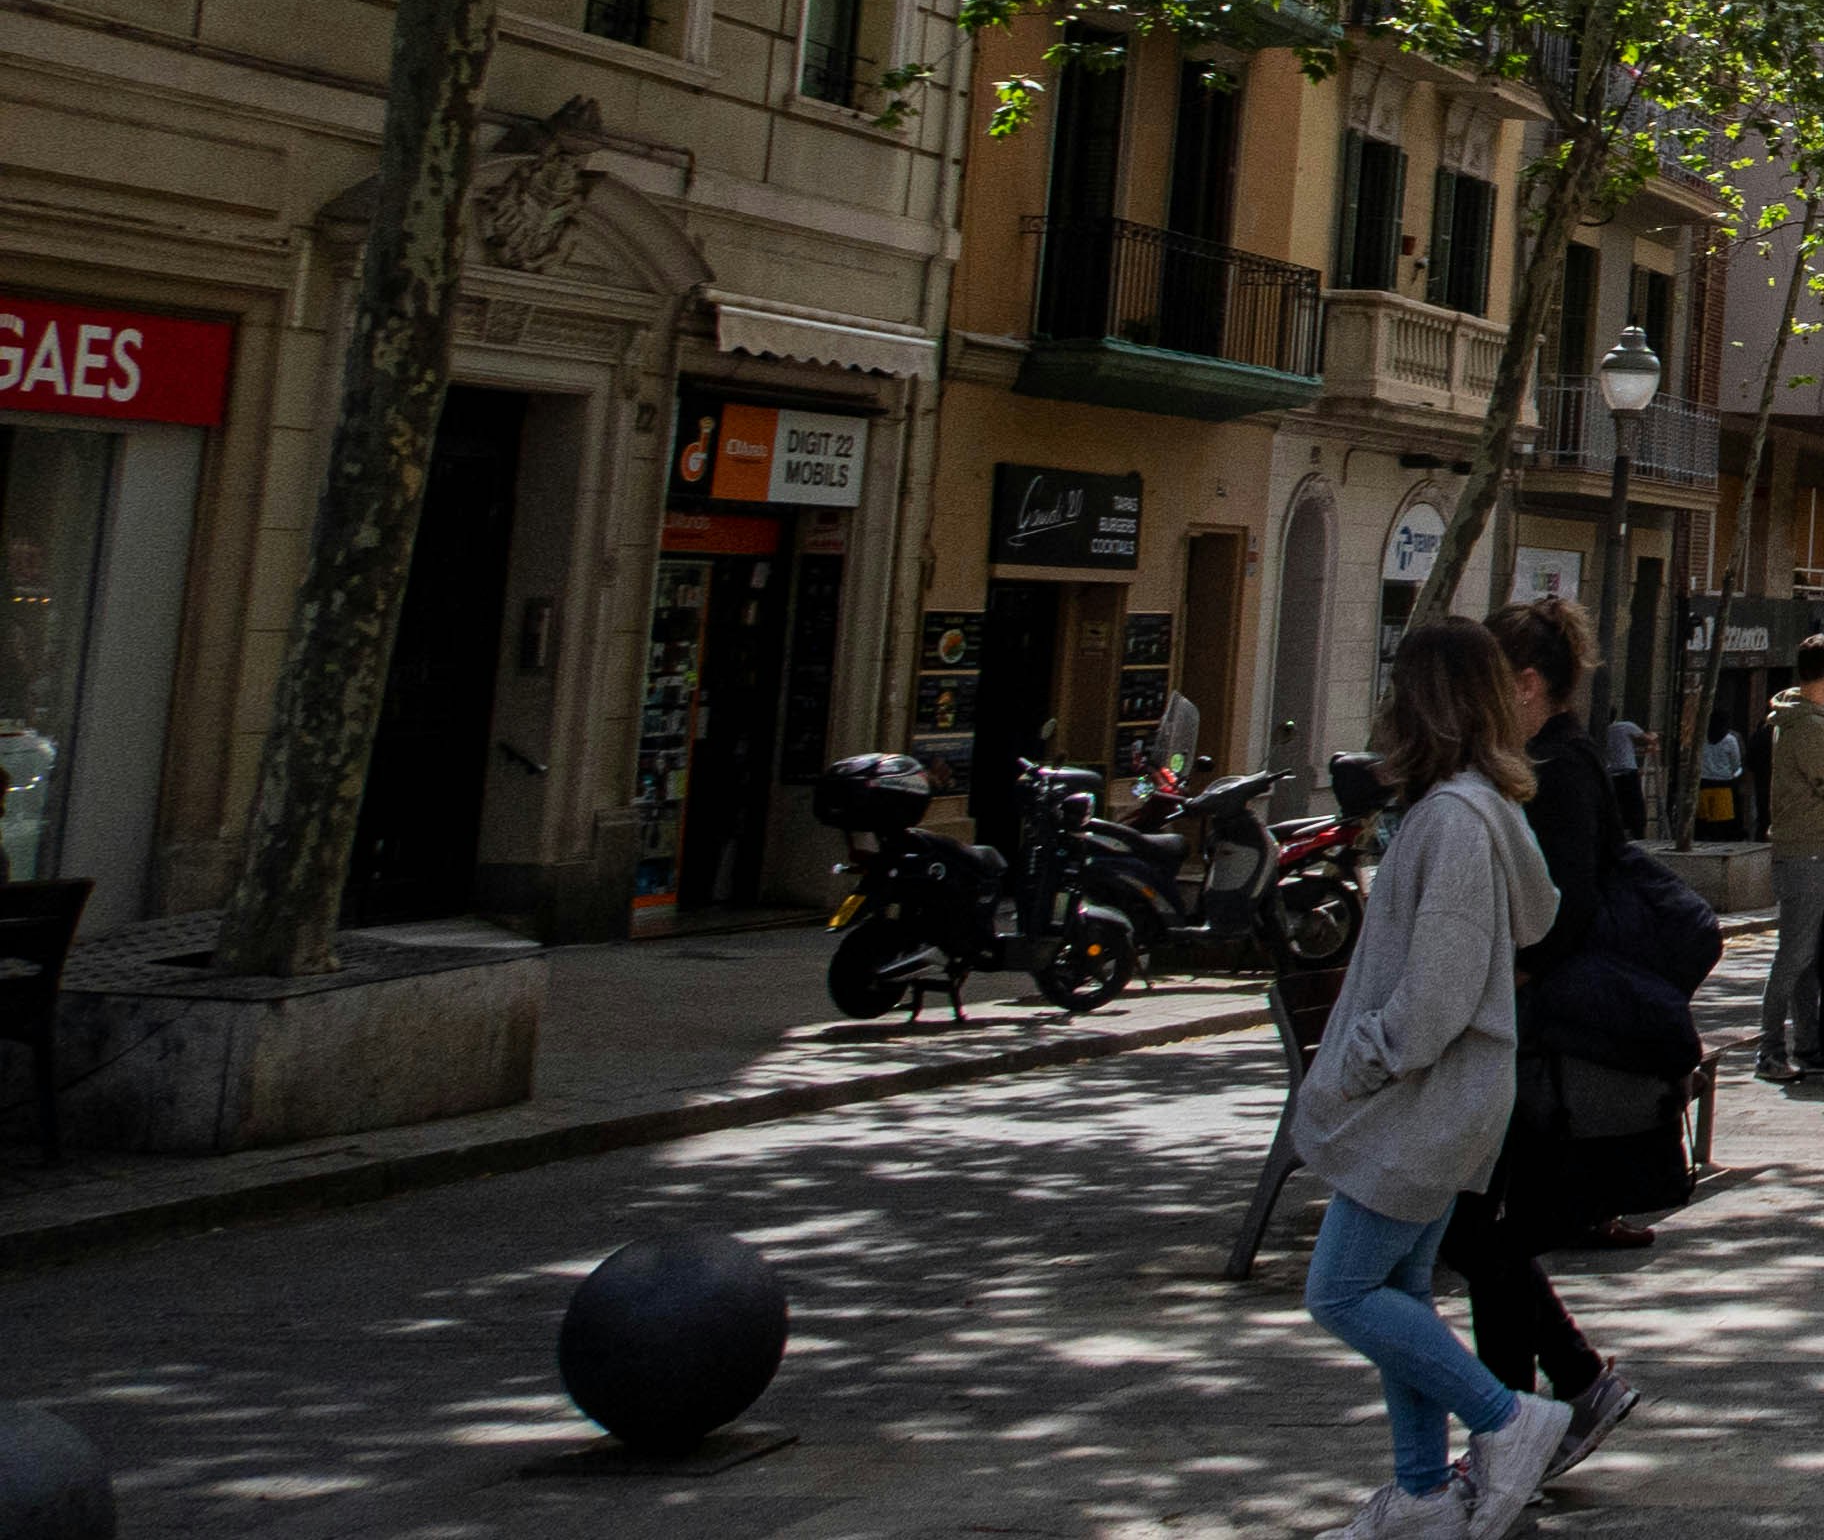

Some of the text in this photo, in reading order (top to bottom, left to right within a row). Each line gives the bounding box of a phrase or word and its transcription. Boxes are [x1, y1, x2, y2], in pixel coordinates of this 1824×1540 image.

[0, 313, 143, 402] GAES
[788, 429, 834, 455] DIGIT
[834, 434, 854, 459] 22
[783, 460, 850, 488] MOBILS
[1098, 516, 1138, 534] BURGERS
